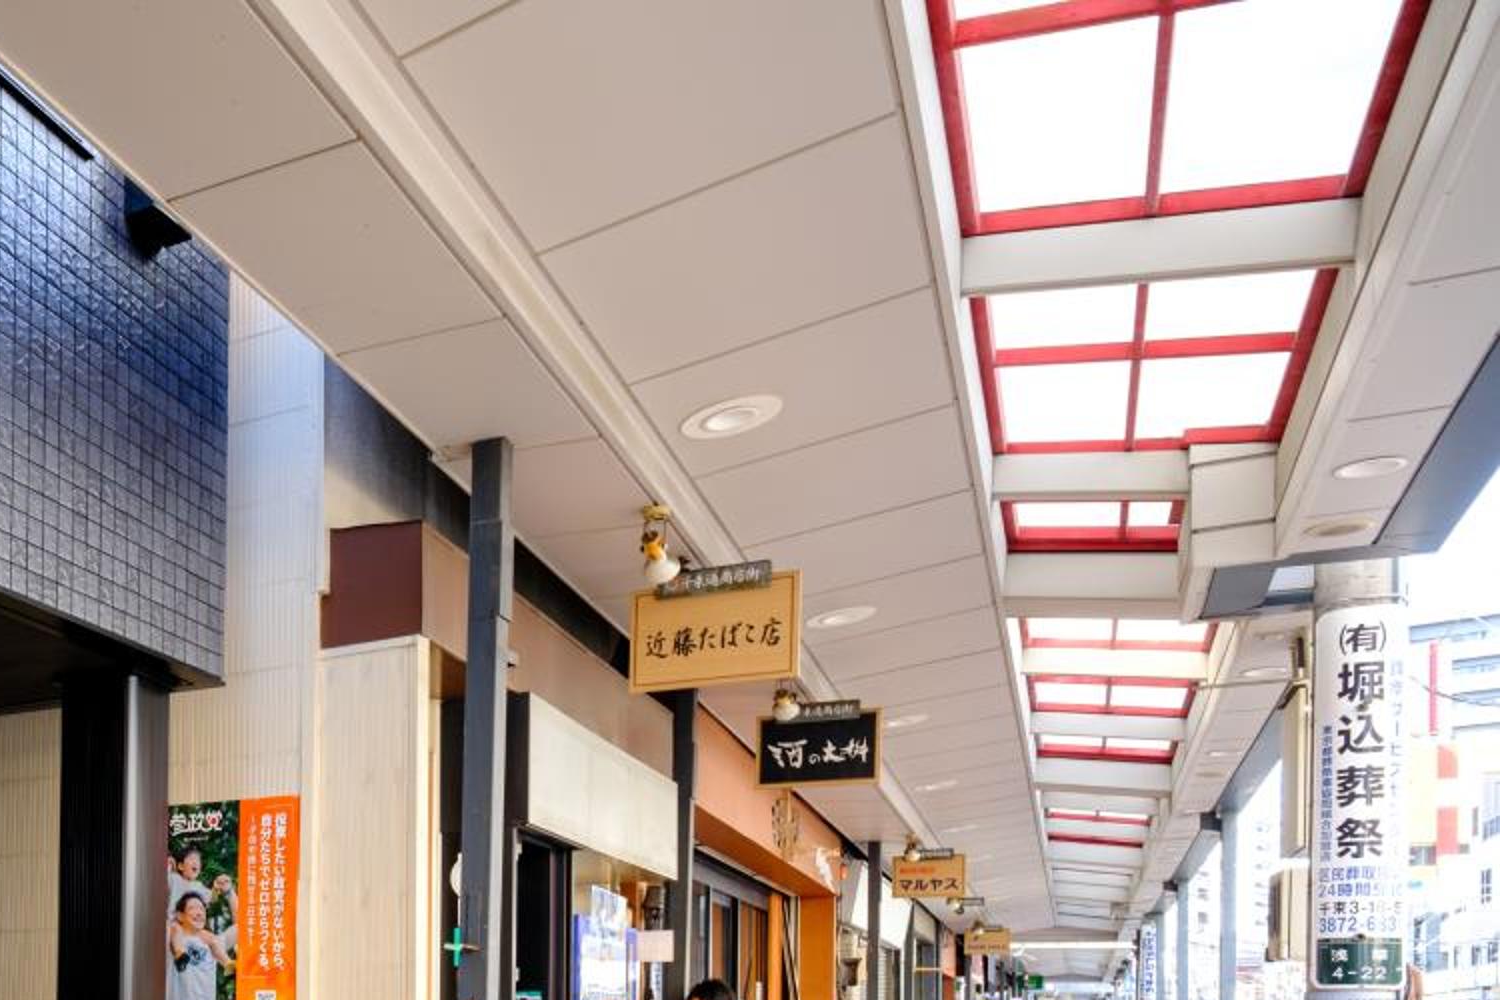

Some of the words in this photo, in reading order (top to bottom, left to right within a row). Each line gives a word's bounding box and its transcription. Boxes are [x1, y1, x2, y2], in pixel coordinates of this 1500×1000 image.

[645, 616, 783, 659] 近藤たばこ店
[169, 810, 223, 837] 参政党
[899, 877, 958, 892] マルヤス
